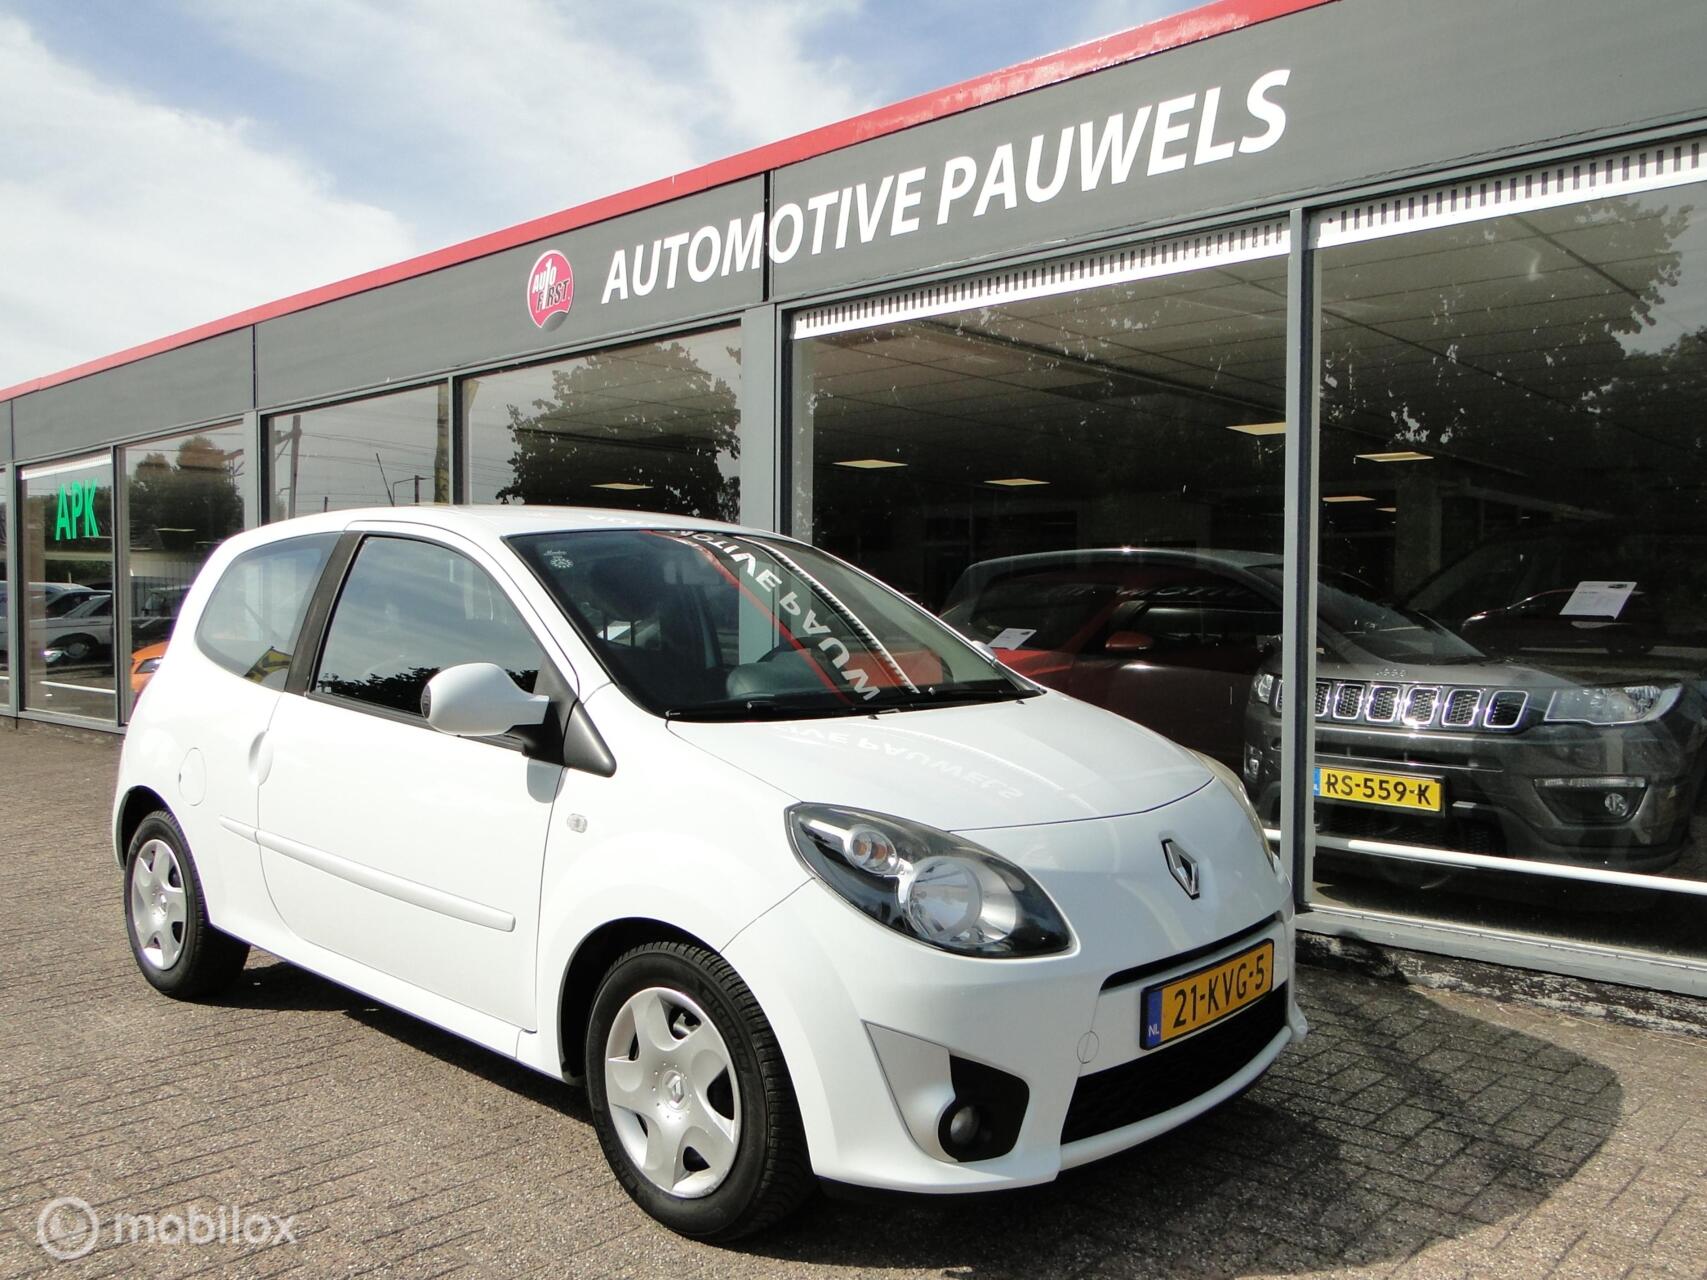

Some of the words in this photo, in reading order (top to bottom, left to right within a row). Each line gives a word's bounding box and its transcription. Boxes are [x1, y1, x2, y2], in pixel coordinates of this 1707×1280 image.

[601, 166, 927, 305] AUTOMOTIVE
[937, 68, 1291, 226] PAUWELS
[55, 478, 100, 541] APK
[1325, 773, 1431, 806] RS-559-K
[1173, 954, 1265, 1029] 21-KVG-5
[1148, 1023, 1160, 1038] NL
